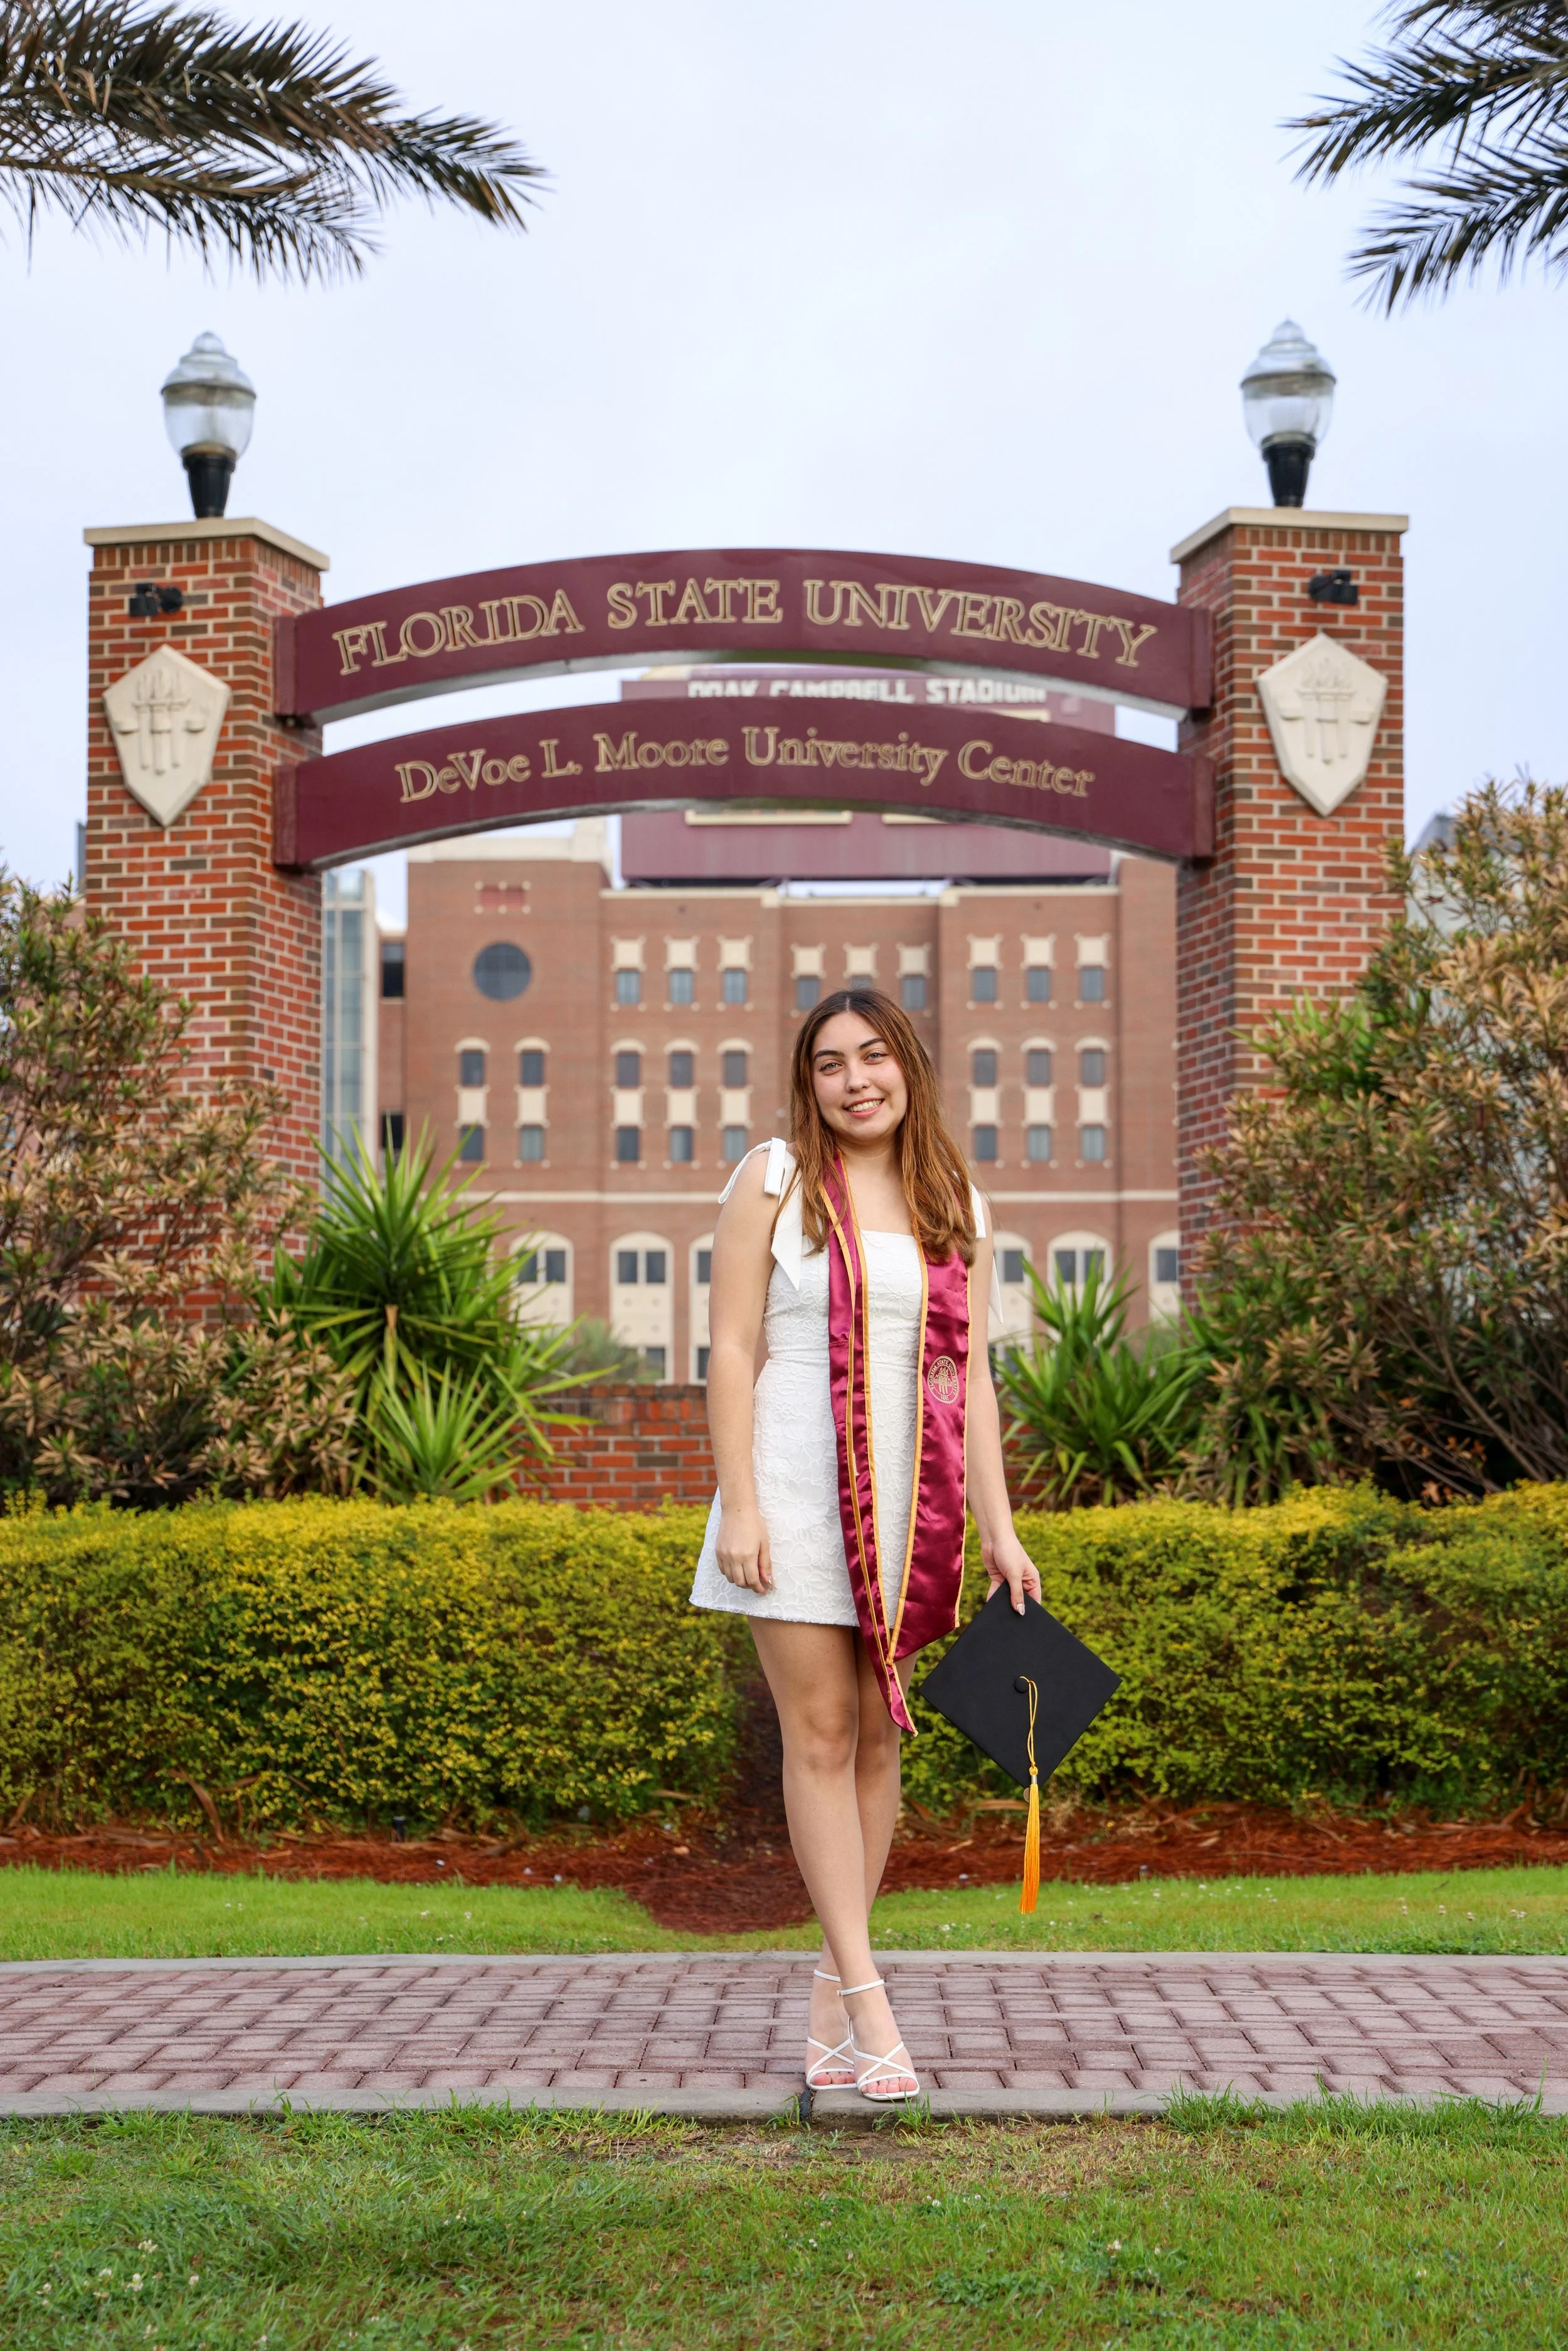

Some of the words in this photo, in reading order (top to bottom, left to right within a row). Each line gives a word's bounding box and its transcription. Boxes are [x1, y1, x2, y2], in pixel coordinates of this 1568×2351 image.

[332, 589, 585, 676] FLORIDA
[607, 578, 784, 630] STATE
[803, 579, 1157, 667] UNIVERSITY
[395, 748, 531, 804] DeVoe
[539, 739, 583, 778] L.
[593, 731, 729, 773] Moore
[741, 726, 949, 787] University
[957, 740, 1096, 797] Center
[929, 1366, 937, 1391] FLORIDA
